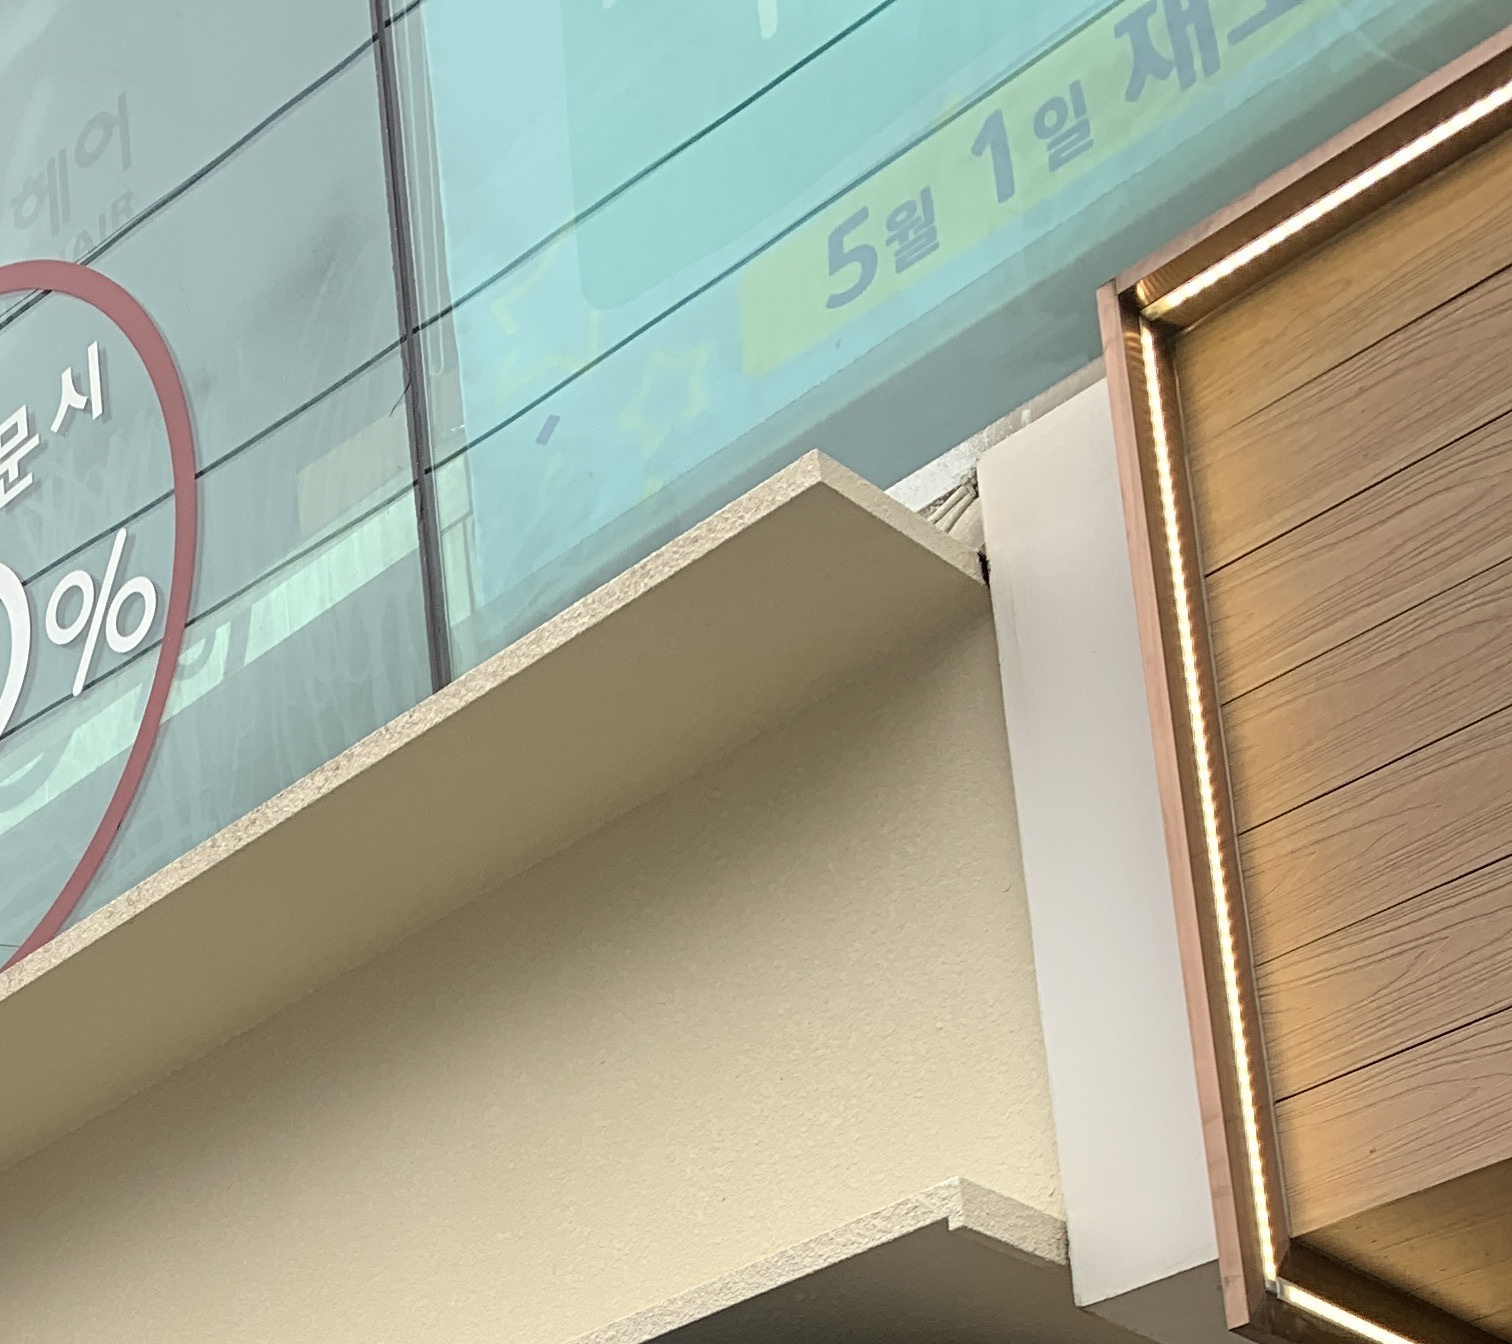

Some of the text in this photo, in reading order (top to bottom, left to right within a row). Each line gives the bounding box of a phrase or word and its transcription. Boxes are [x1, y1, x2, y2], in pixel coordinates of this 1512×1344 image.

[826, 0, 1316, 311] 5월 1일 재
